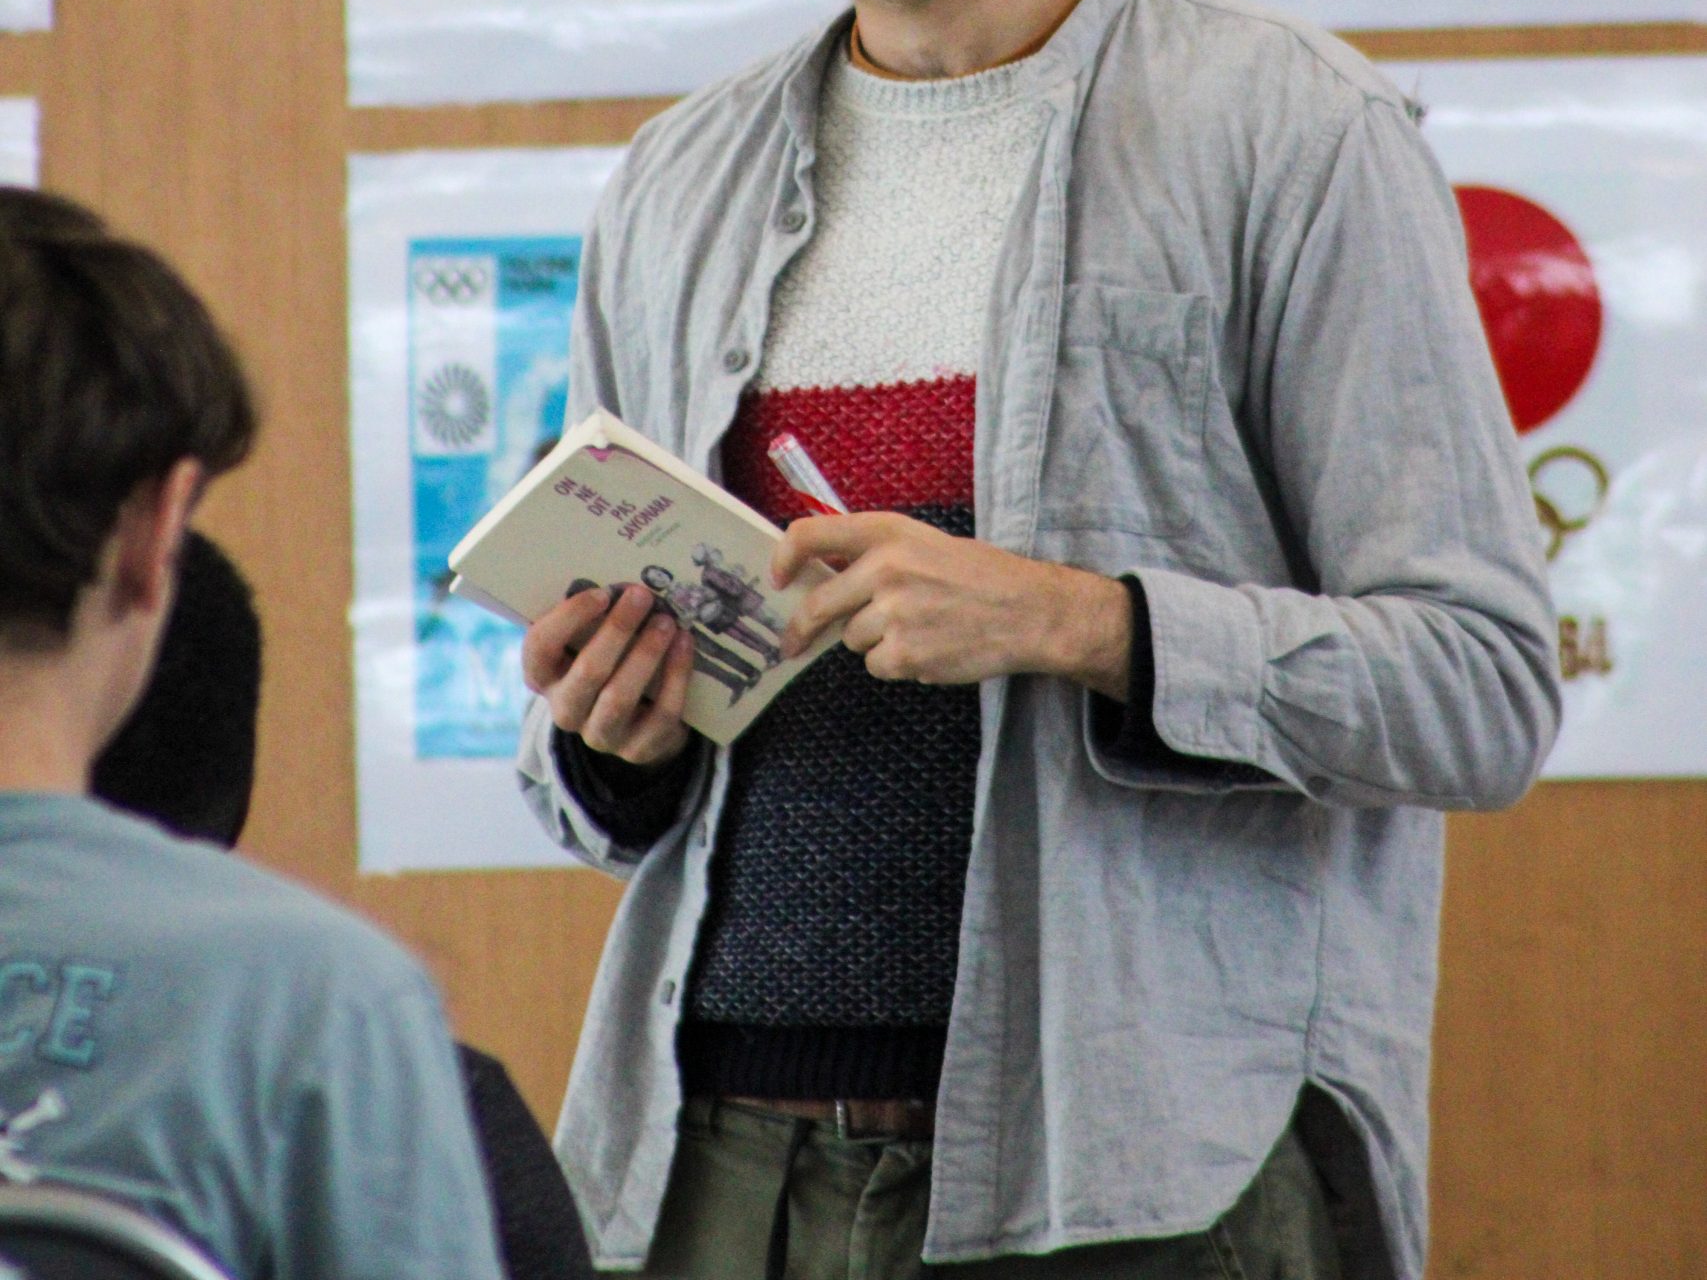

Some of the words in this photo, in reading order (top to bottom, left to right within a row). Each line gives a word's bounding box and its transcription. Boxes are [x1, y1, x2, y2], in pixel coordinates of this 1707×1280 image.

[553, 475, 578, 496] ON
[574, 484, 598, 503] NE
[587, 495, 611, 517] DIT
[610, 500, 637, 521] PAS
[616, 495, 674, 540] SAYONARA
